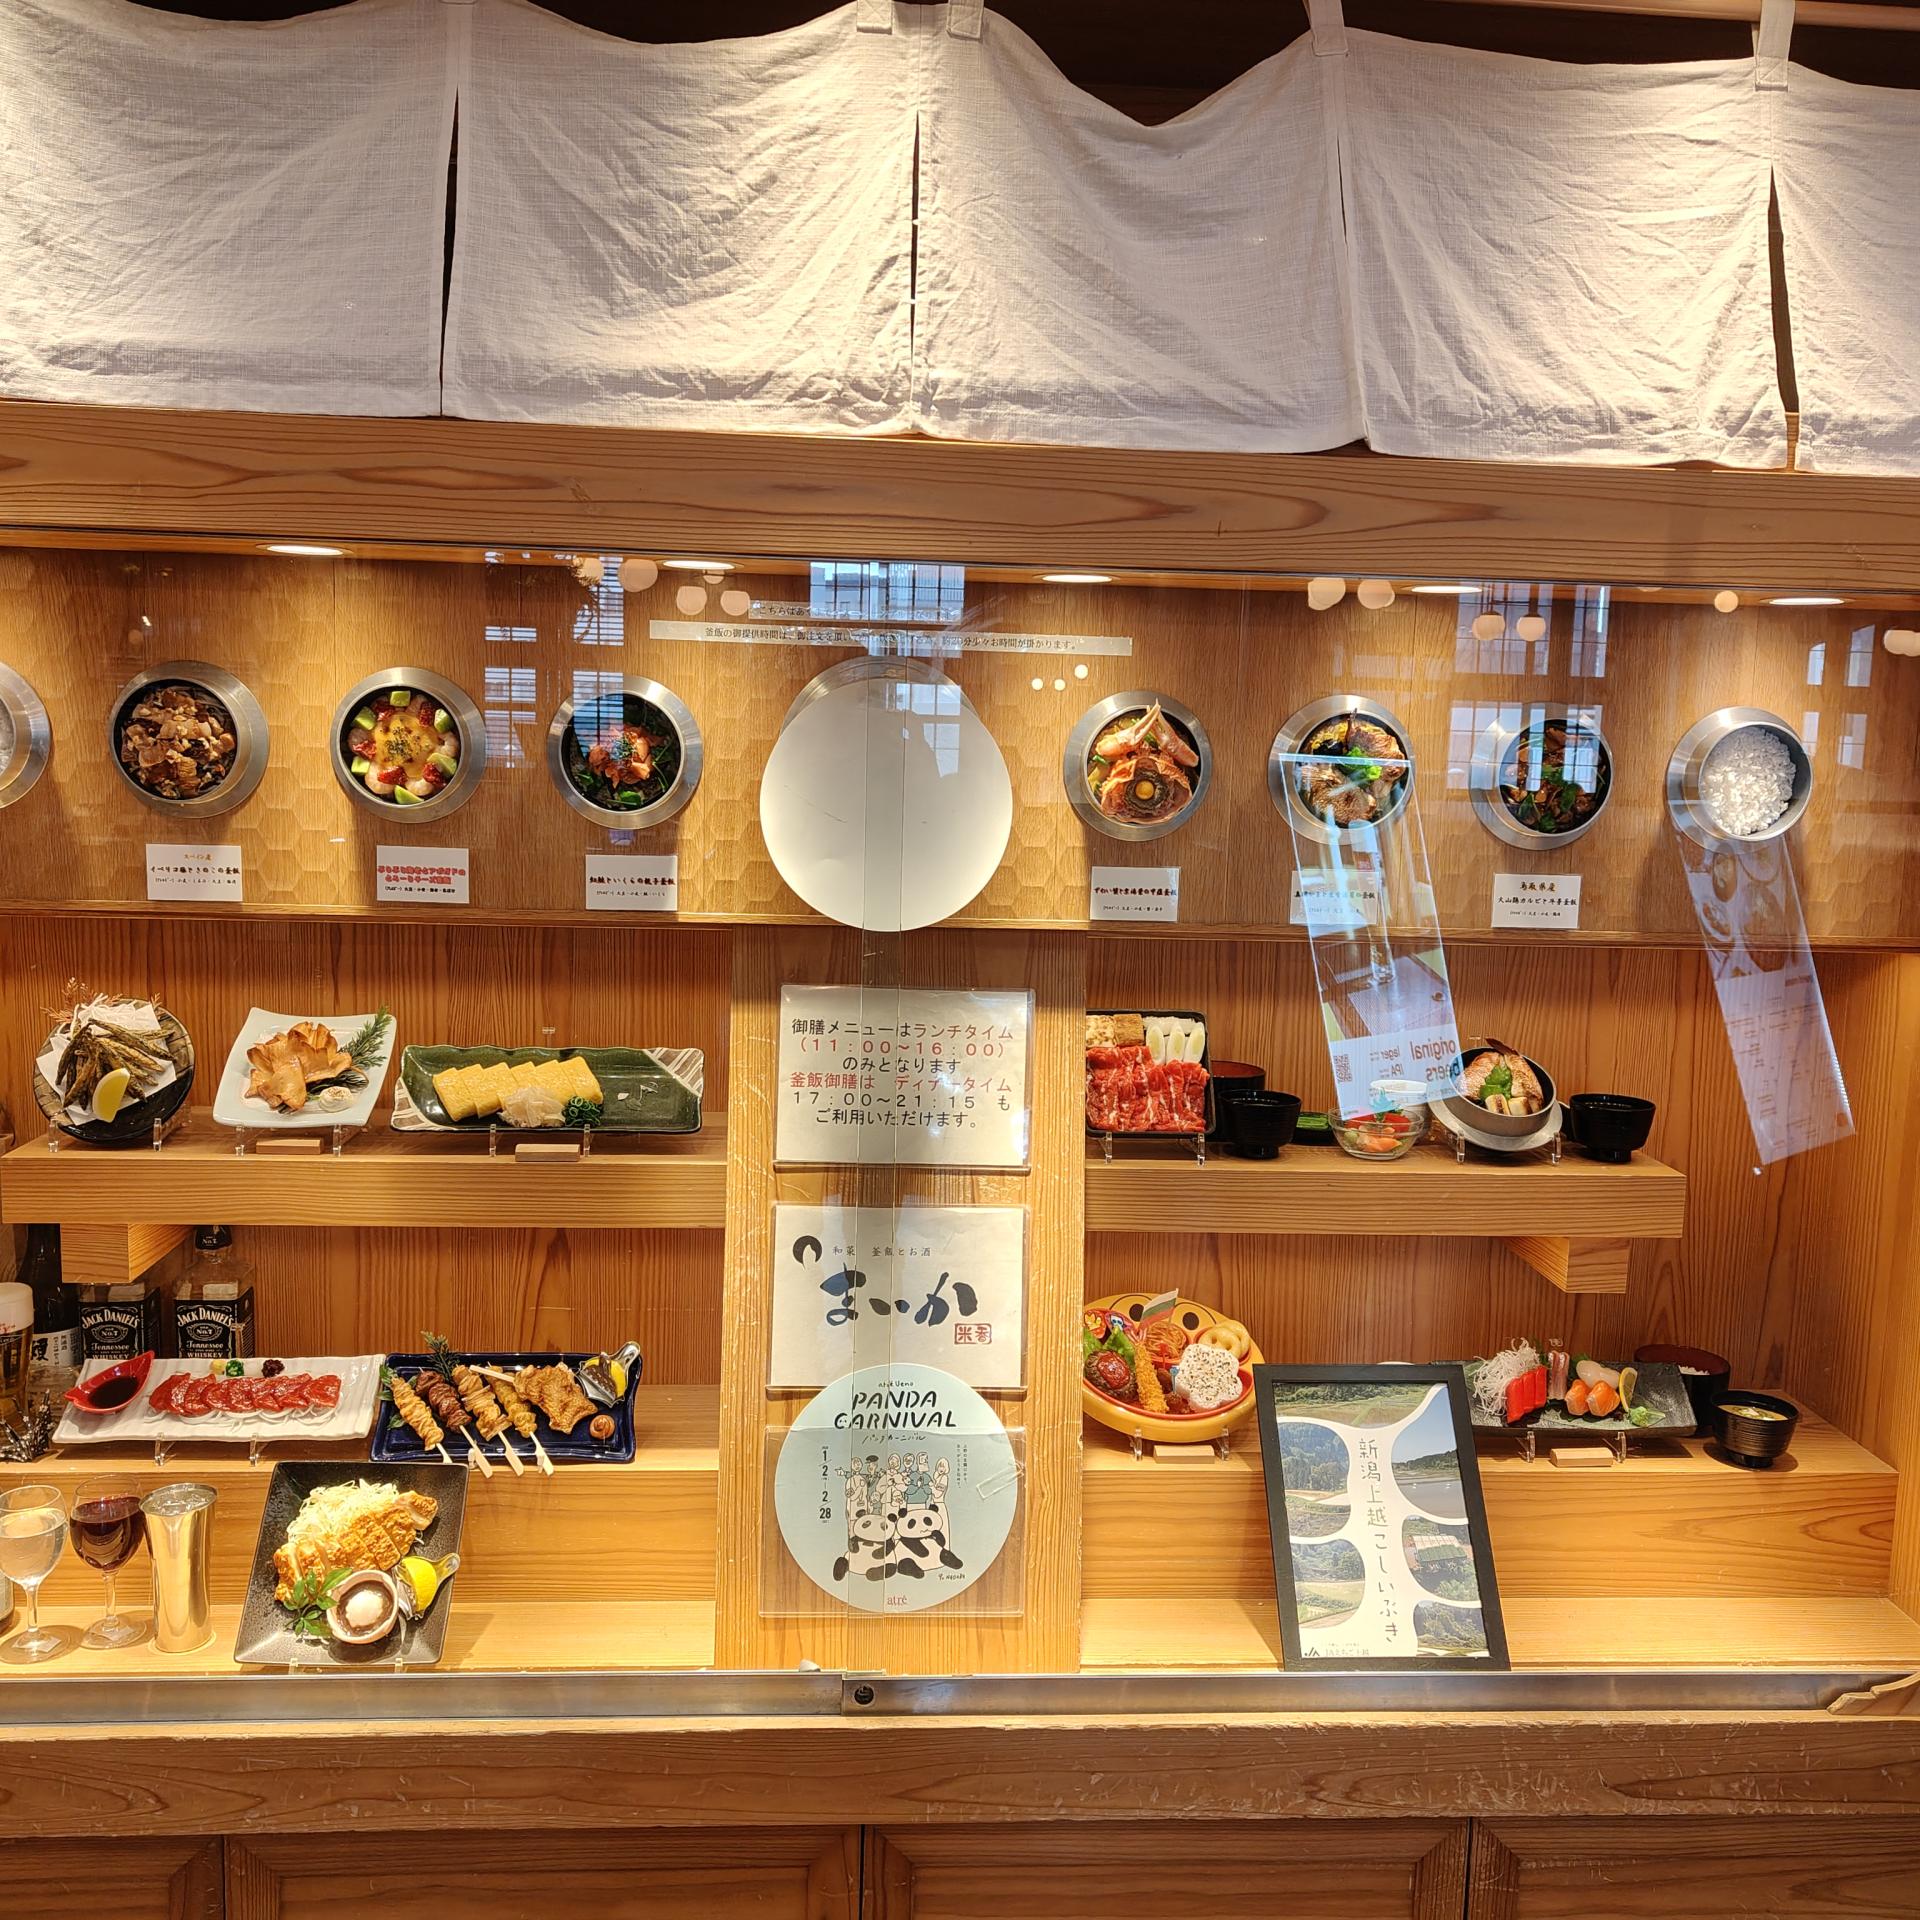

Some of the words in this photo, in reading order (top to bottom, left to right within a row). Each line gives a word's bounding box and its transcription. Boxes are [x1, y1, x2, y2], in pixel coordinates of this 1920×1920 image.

[791, 1018, 1014, 1041] 御膳メニューはランチタイム
[843, 1057, 962, 1074] のみとなります
[790, 1072, 875, 1089] 釜飯御膳は
[816, 1109, 977, 1129] ご利用いただけます。
[820, 1261, 978, 1327] まいか
[81, 1312, 104, 1329] JACK
[177, 1311, 199, 1328] JACK
[91, 1342, 130, 1351] Tennessee
[186, 1340, 224, 1349] Tennessee
[853, 1390, 938, 1410] PANDA
[834, 1410, 957, 1430] CARNIVAL
[1358, 1437, 1399, 1643] 新潟上越こしいぶき
